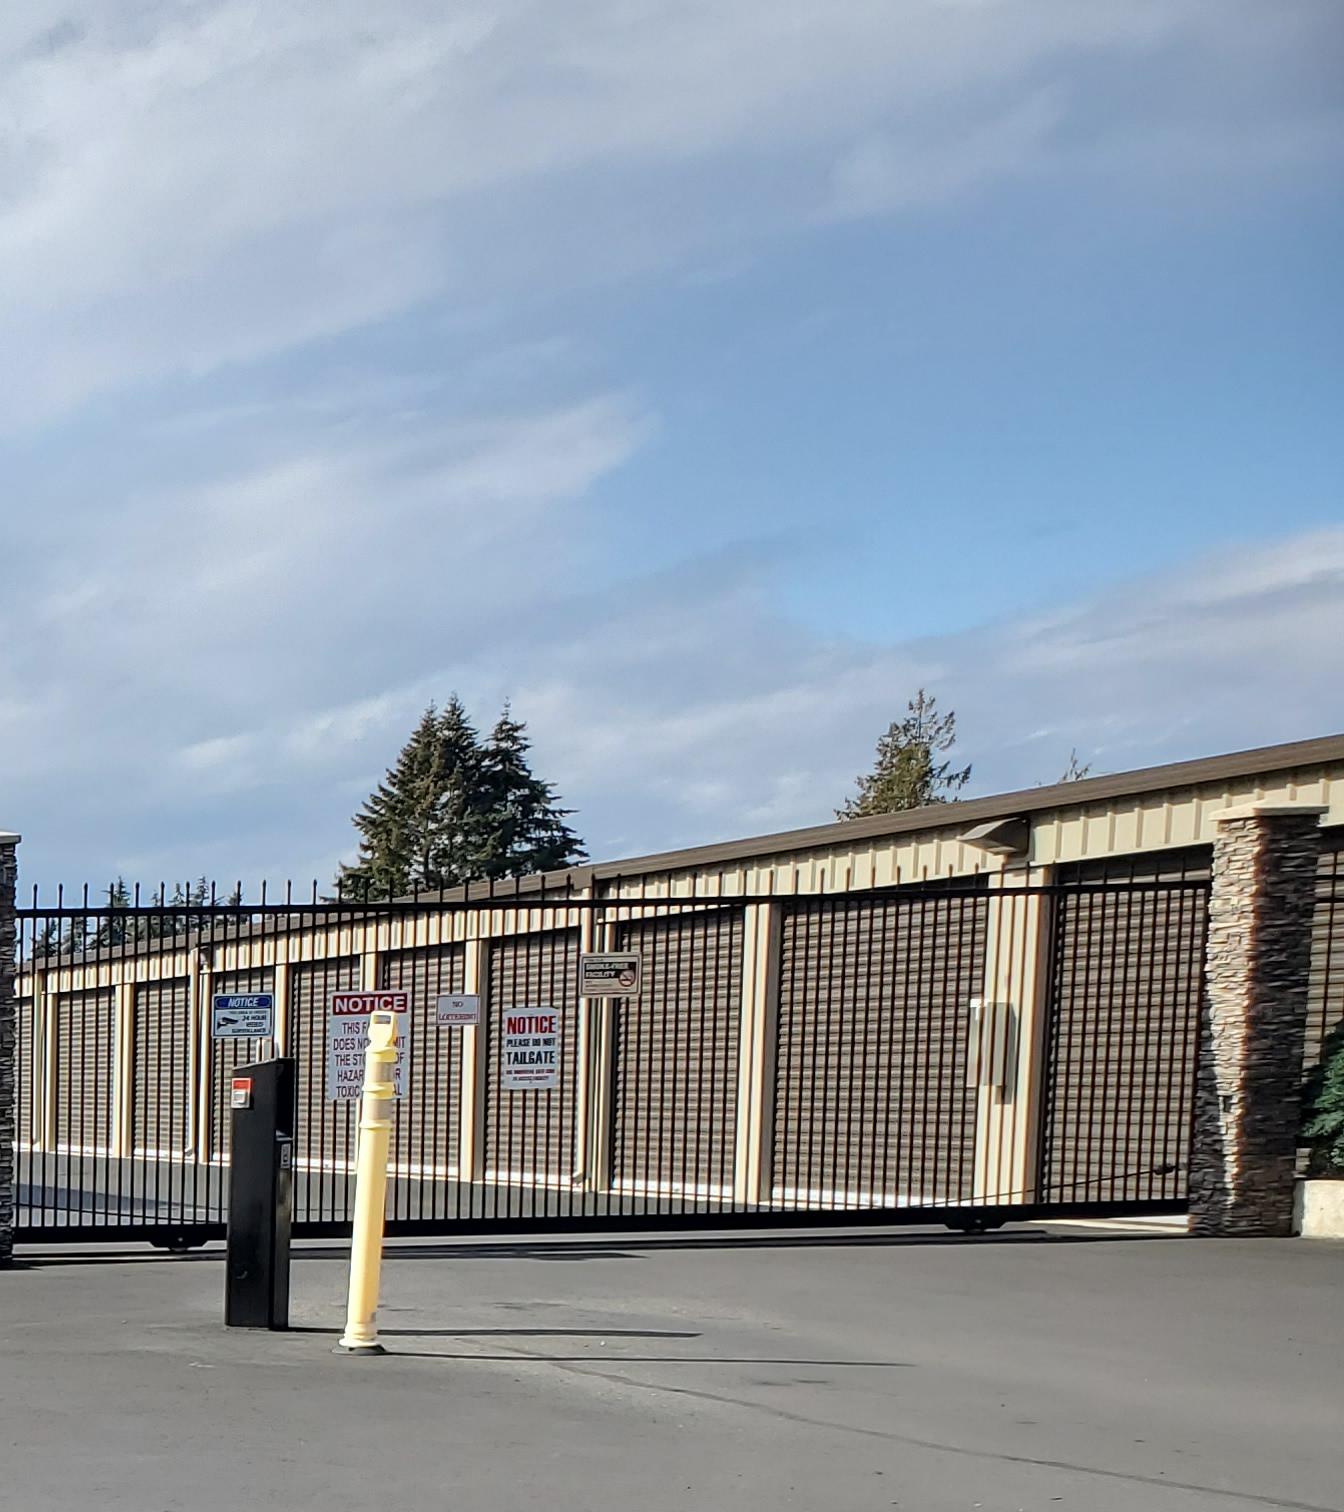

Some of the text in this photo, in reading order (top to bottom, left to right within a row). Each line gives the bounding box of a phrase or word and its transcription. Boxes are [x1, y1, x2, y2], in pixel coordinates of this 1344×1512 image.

[228, 997, 259, 1008] NOTICE
[335, 996, 405, 1012] NOTICE
[342, 1021, 361, 1035] THIS
[507, 1016, 557, 1035] NOTICE
[333, 1038, 370, 1051] DOES NO
[506, 1038, 530, 1047] PLEASE
[543, 1037, 557, 1046] NOT
[335, 1054, 351, 1067] THE
[506, 1050, 555, 1065] TAILGATE
[336, 1085, 360, 1098] TOXIC
